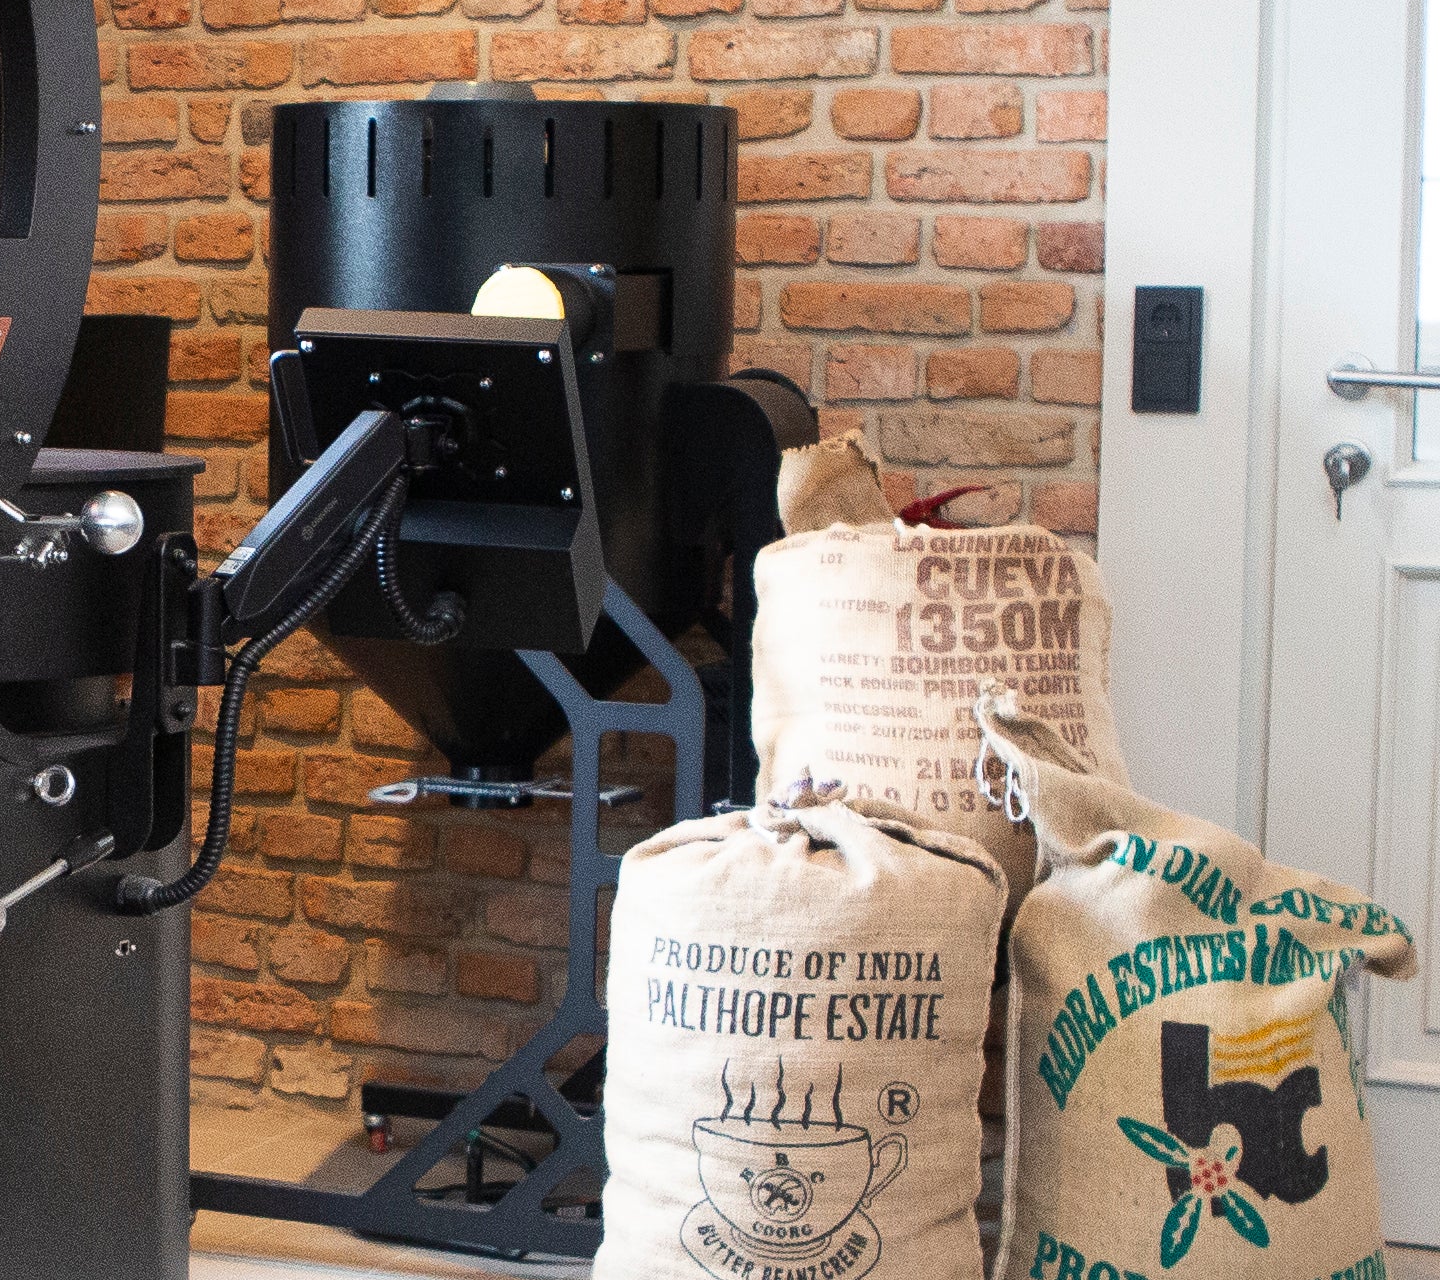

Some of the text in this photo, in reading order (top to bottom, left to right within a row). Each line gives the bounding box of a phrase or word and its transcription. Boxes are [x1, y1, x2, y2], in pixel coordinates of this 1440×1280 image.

[917, 554, 1083, 601] CUEVA
[894, 599, 1081, 655] 1350M
[890, 654, 1007, 676] BOURBON
[1023, 674, 1082, 697] CORTE
[651, 936, 943, 983] PRODUCE OF INDIA
[1108, 929, 1246, 1020] ESTATES
[648, 976, 945, 1042] PALTHOPE ESTATE
